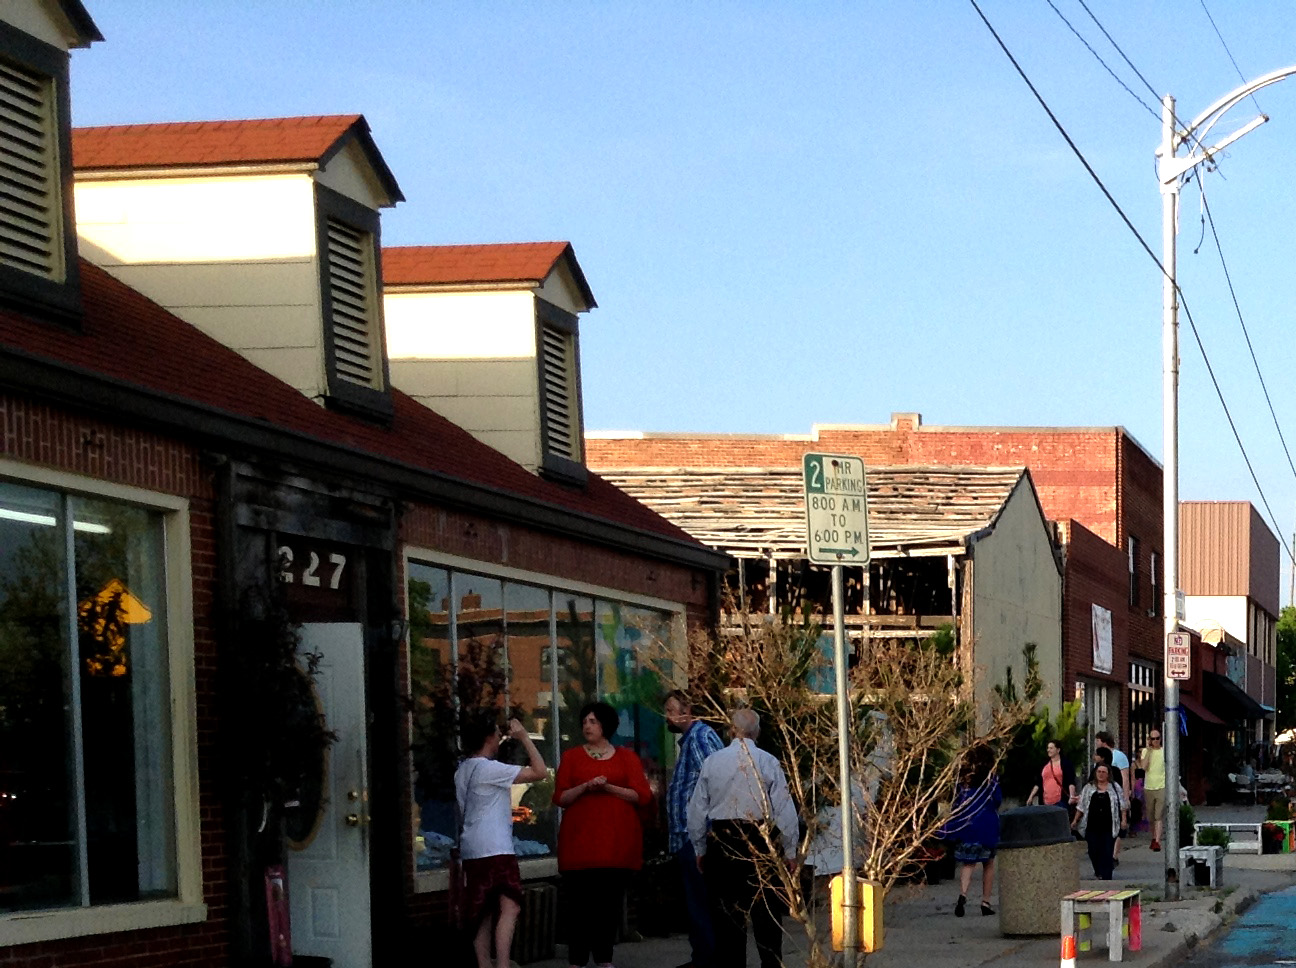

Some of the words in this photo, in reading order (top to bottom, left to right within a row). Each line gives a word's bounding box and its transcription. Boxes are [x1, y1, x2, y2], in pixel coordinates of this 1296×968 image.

[810, 461, 821, 488] 2
[836, 461, 851, 475] HR
[825, 477, 862, 492] PARKING
[831, 513, 846, 527] TO
[278, 545, 347, 590] 227
